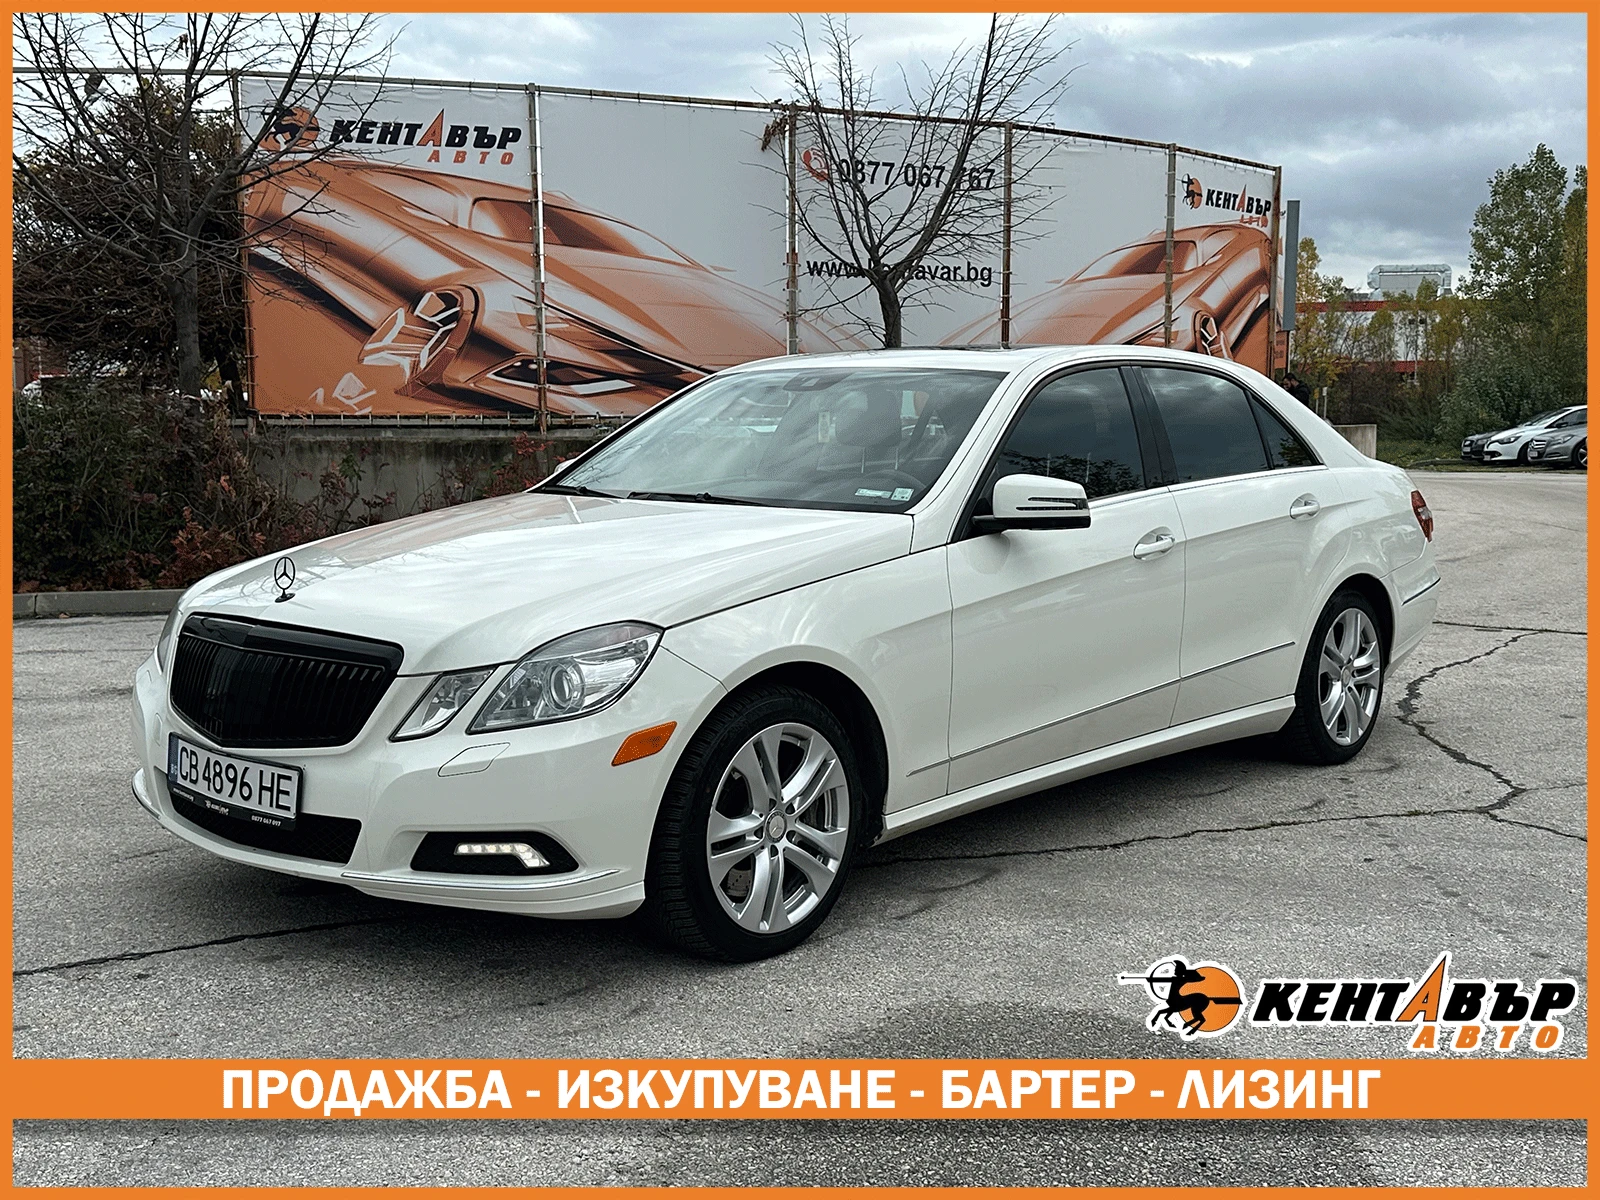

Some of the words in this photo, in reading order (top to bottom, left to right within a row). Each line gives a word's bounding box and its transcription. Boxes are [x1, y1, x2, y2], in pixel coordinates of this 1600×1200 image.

[329, 108, 522, 149] КЕНТАВЪР
[427, 149, 515, 165] АВТО
[838, 158, 895, 186] 0877
[903, 163, 945, 188] 067
[1205, 184, 1272, 216] КЕНТАВЪР
[806, 257, 992, 287] wwwavar.bg
